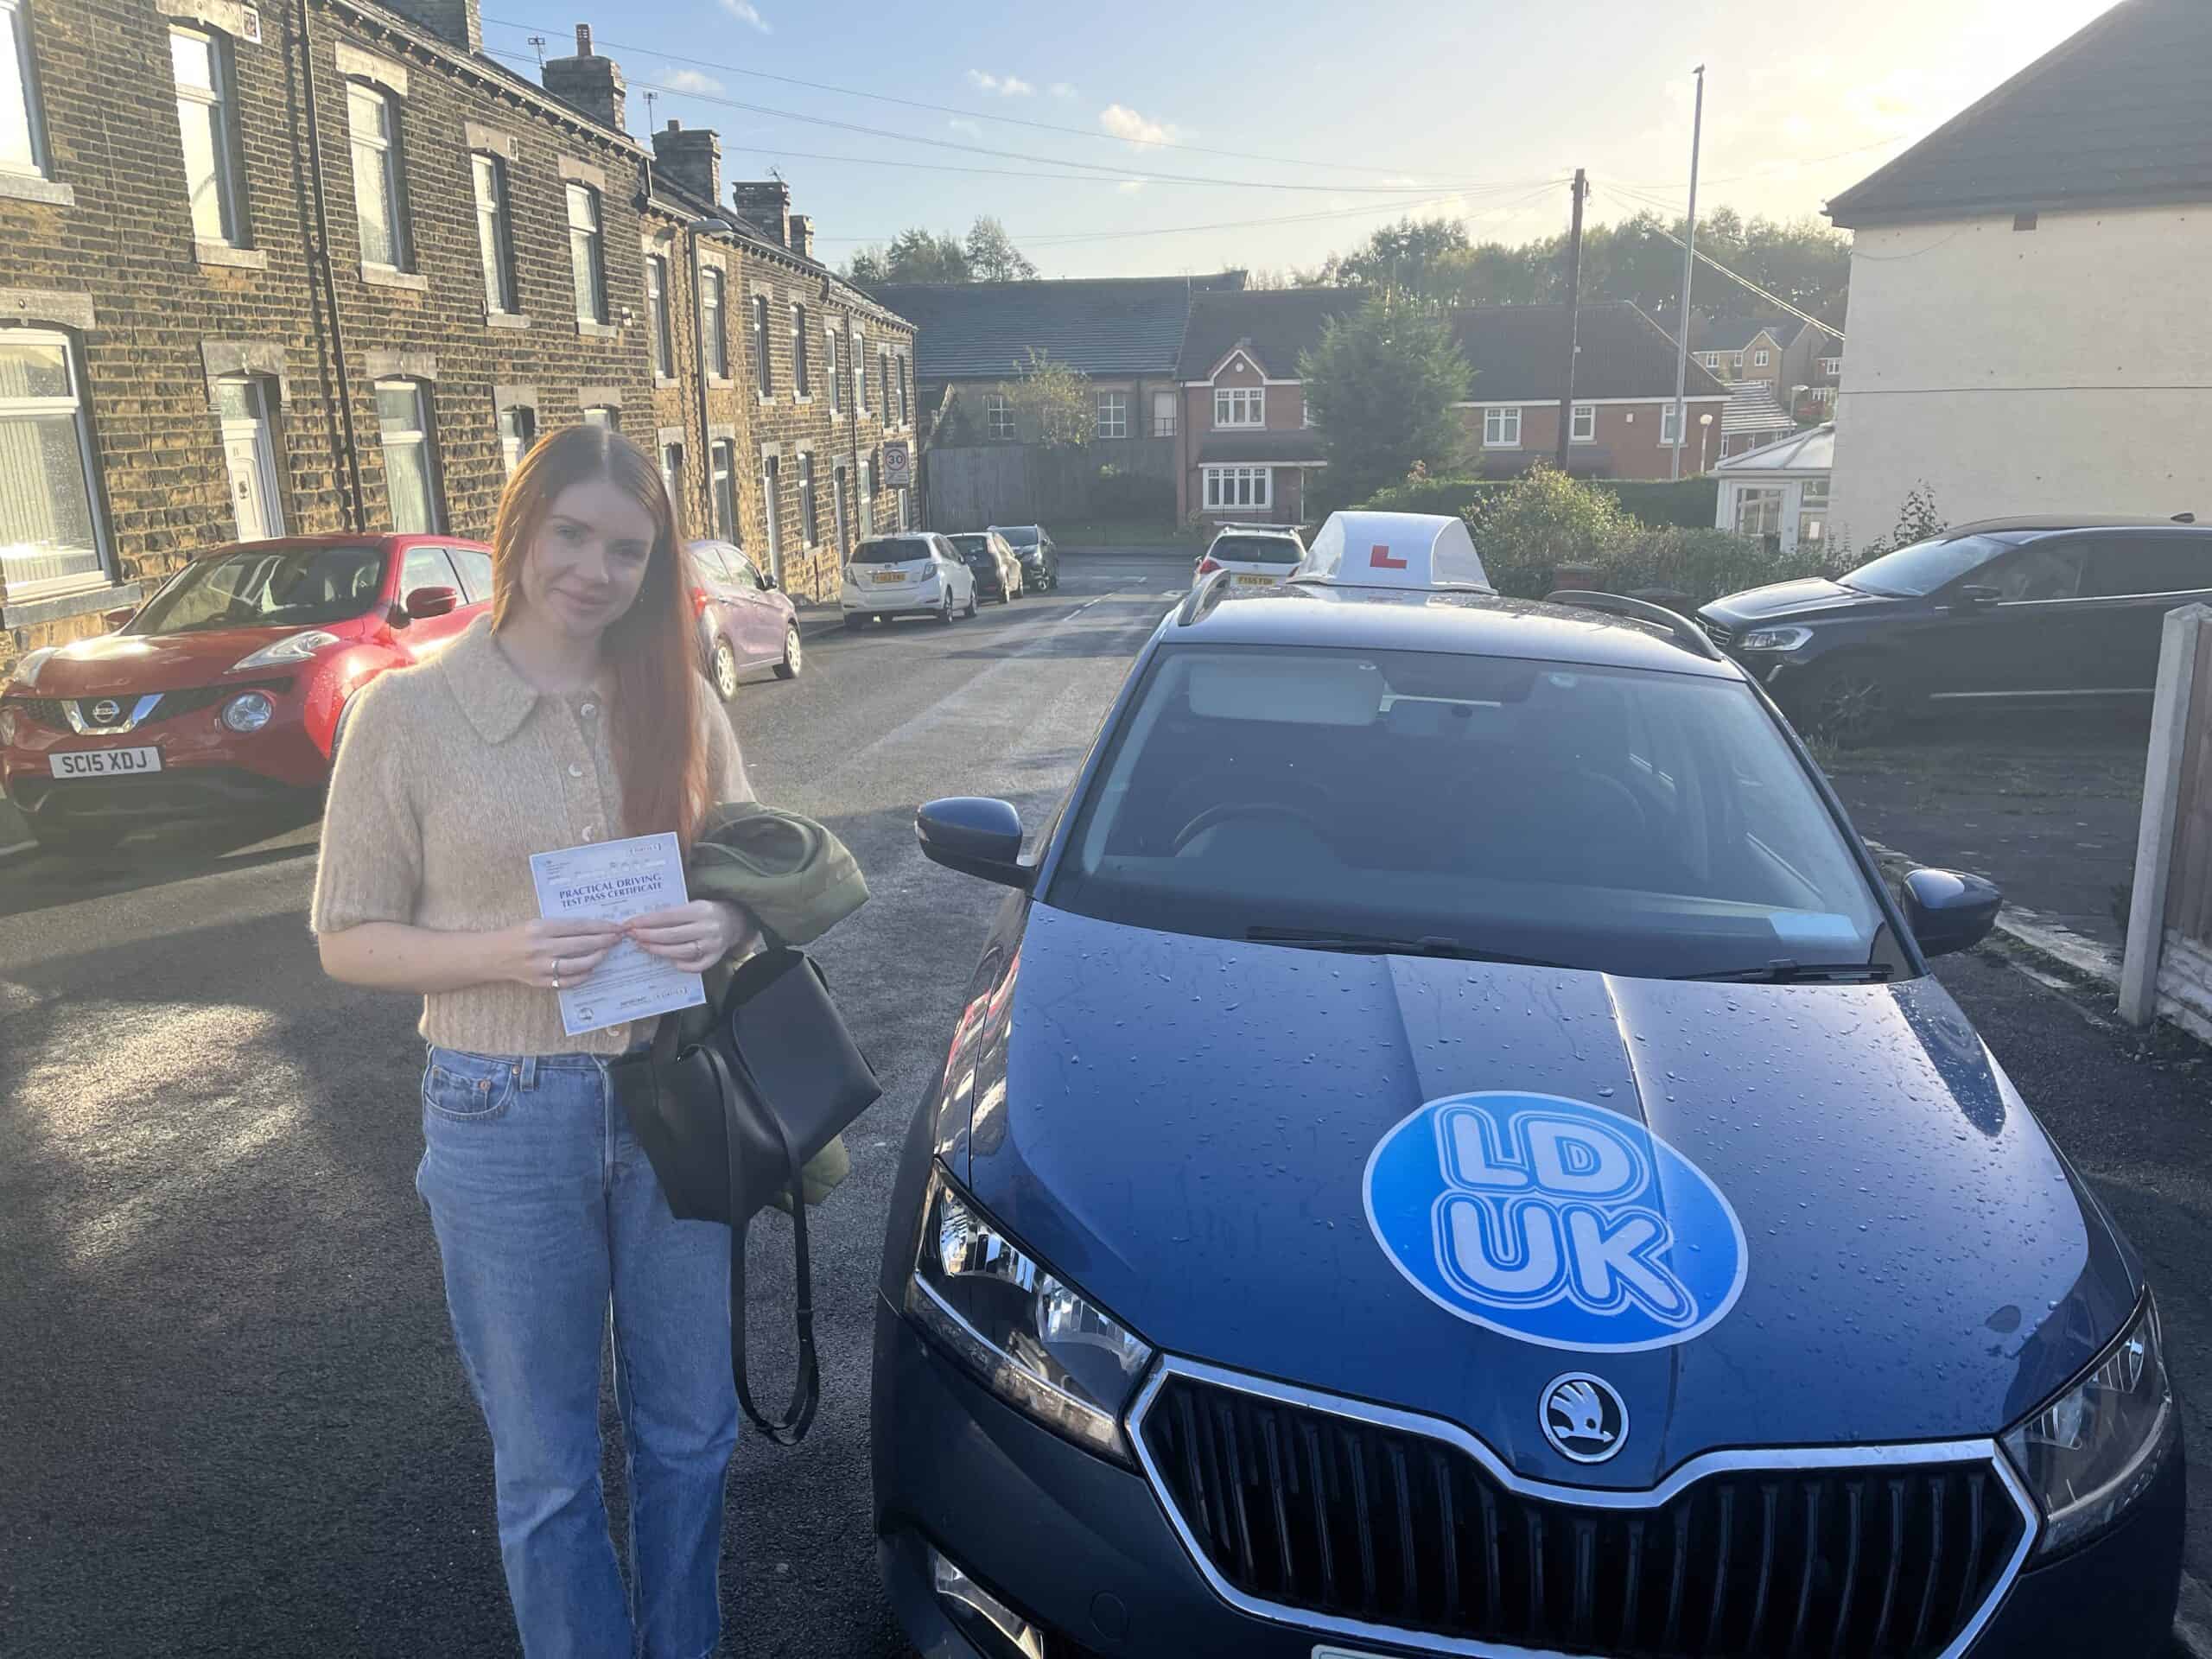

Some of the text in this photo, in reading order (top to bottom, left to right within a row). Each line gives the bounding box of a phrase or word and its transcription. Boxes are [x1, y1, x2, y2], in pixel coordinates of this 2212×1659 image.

[888, 454, 903, 465] 30
[1370, 545, 1408, 569] L
[61, 750, 148, 773] SC15 XDJ
[559, 873, 662, 899] PRACTICAL DRIVING
[562, 881, 663, 907] TEST PASS CERTIFICATE
[1438, 1106, 1646, 1200] LD
[1436, 1192, 1694, 1324] UK
